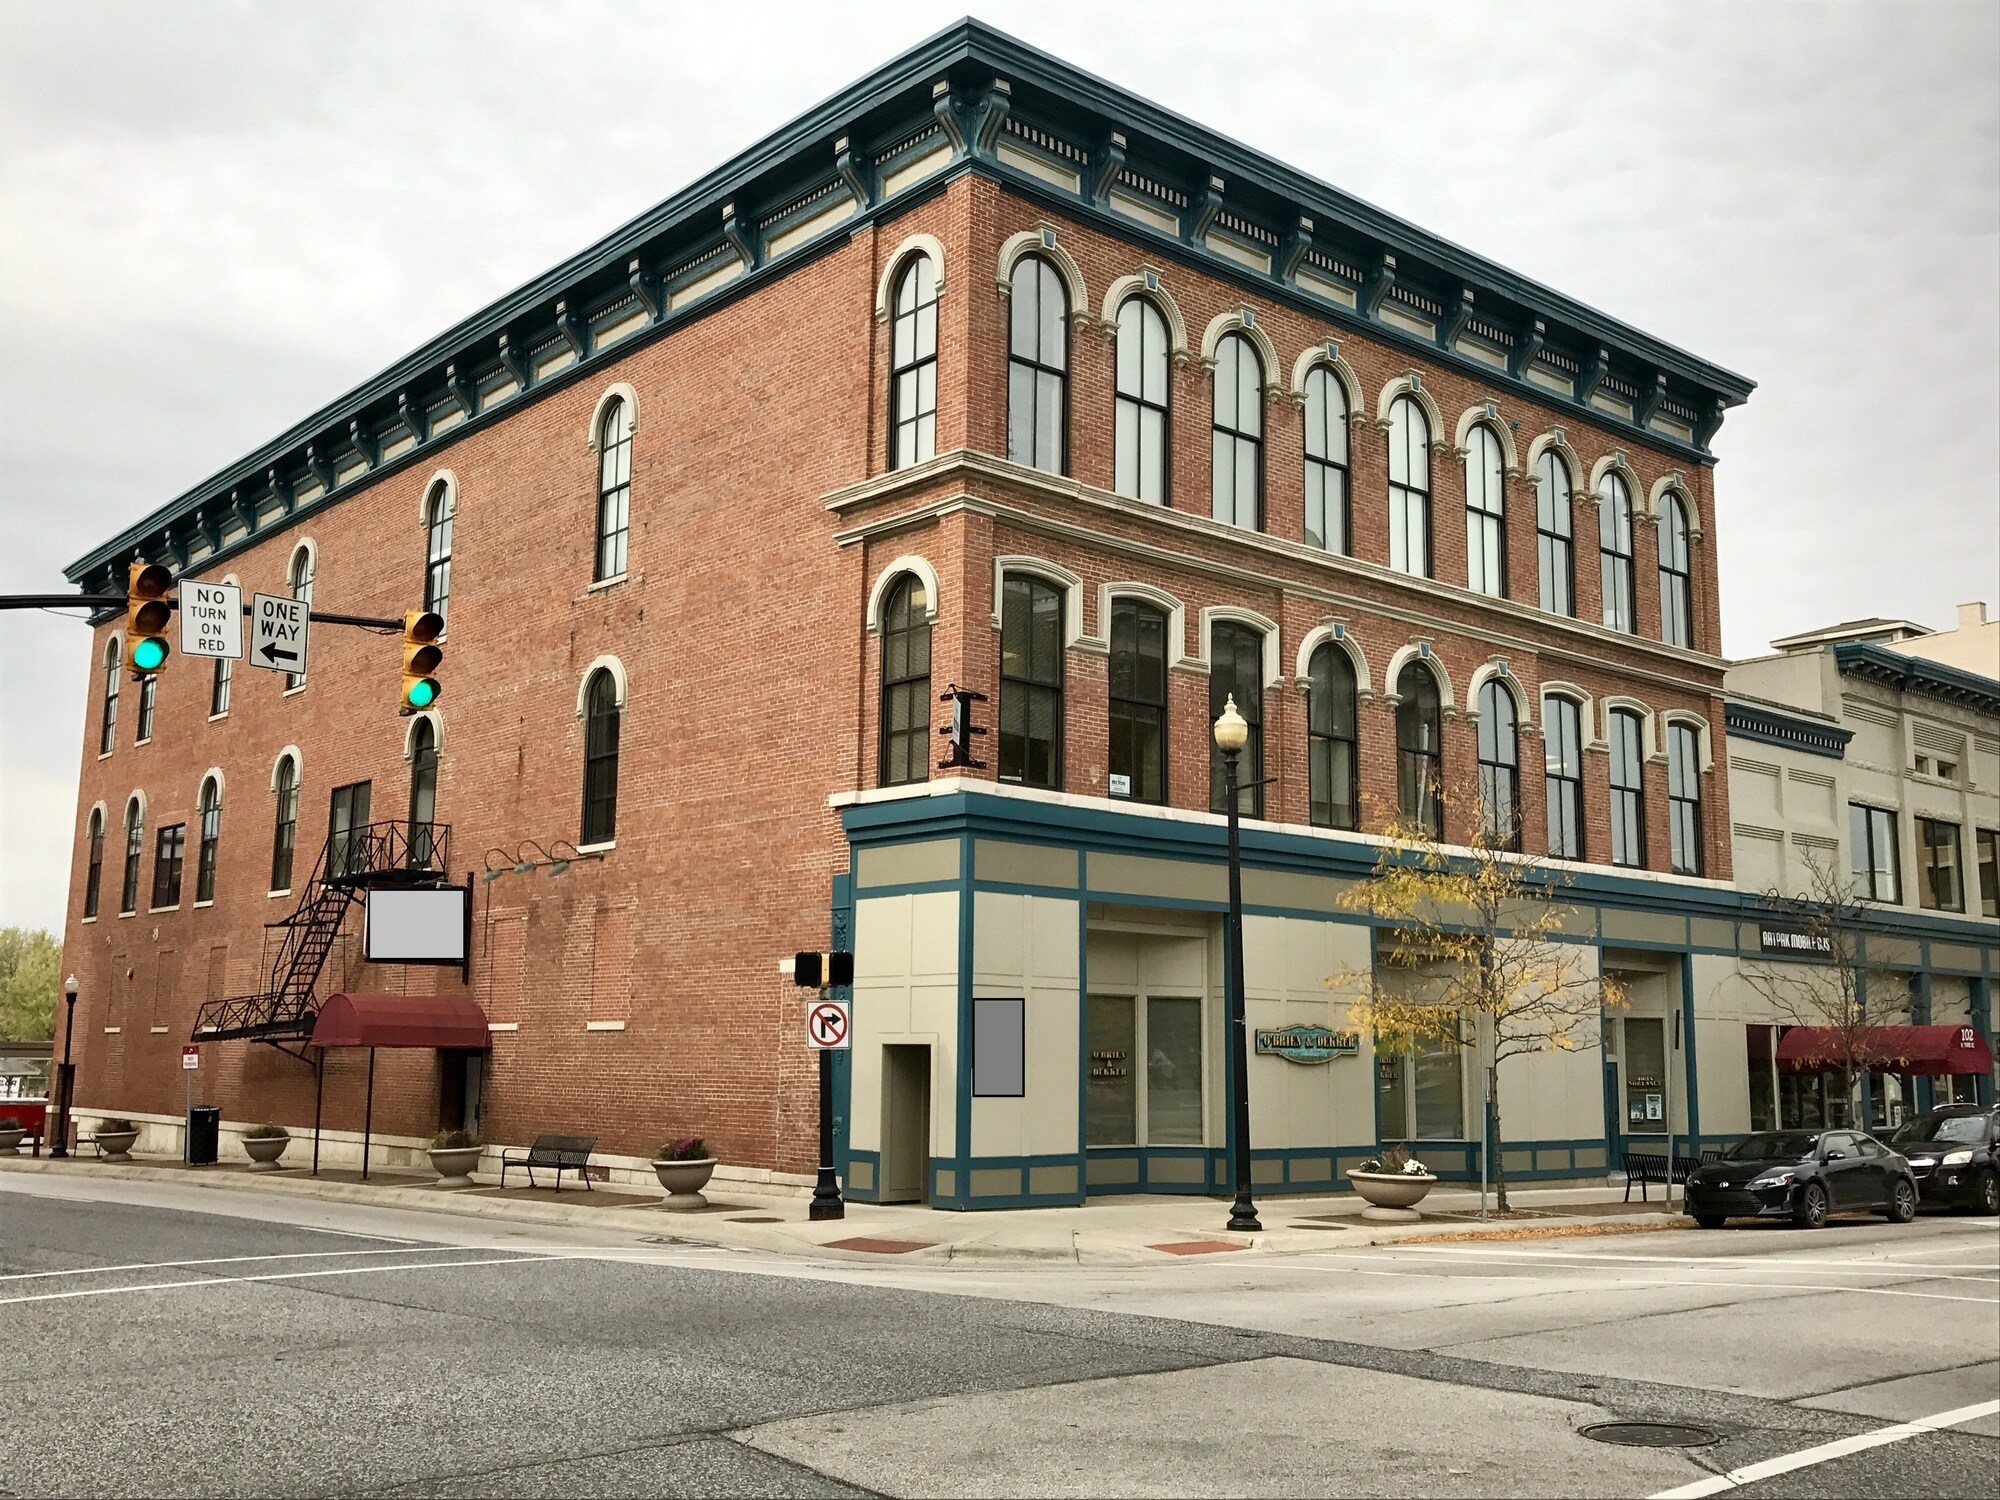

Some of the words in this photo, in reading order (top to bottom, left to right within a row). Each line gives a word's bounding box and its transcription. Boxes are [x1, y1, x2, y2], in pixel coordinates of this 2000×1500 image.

[197, 588, 225, 604] NO
[191, 605, 226, 620] TURN
[263, 600, 299, 622] ONE
[201, 622, 221, 635] ON
[261, 619, 300, 641] WAY
[198, 638, 225, 651] RED
[1790, 933, 1816, 950] MOBILE
[1305, 1035, 1313, 1048] &
[1317, 1035, 1355, 1049] DEKKER
[1961, 1028, 1974, 1041] 102
